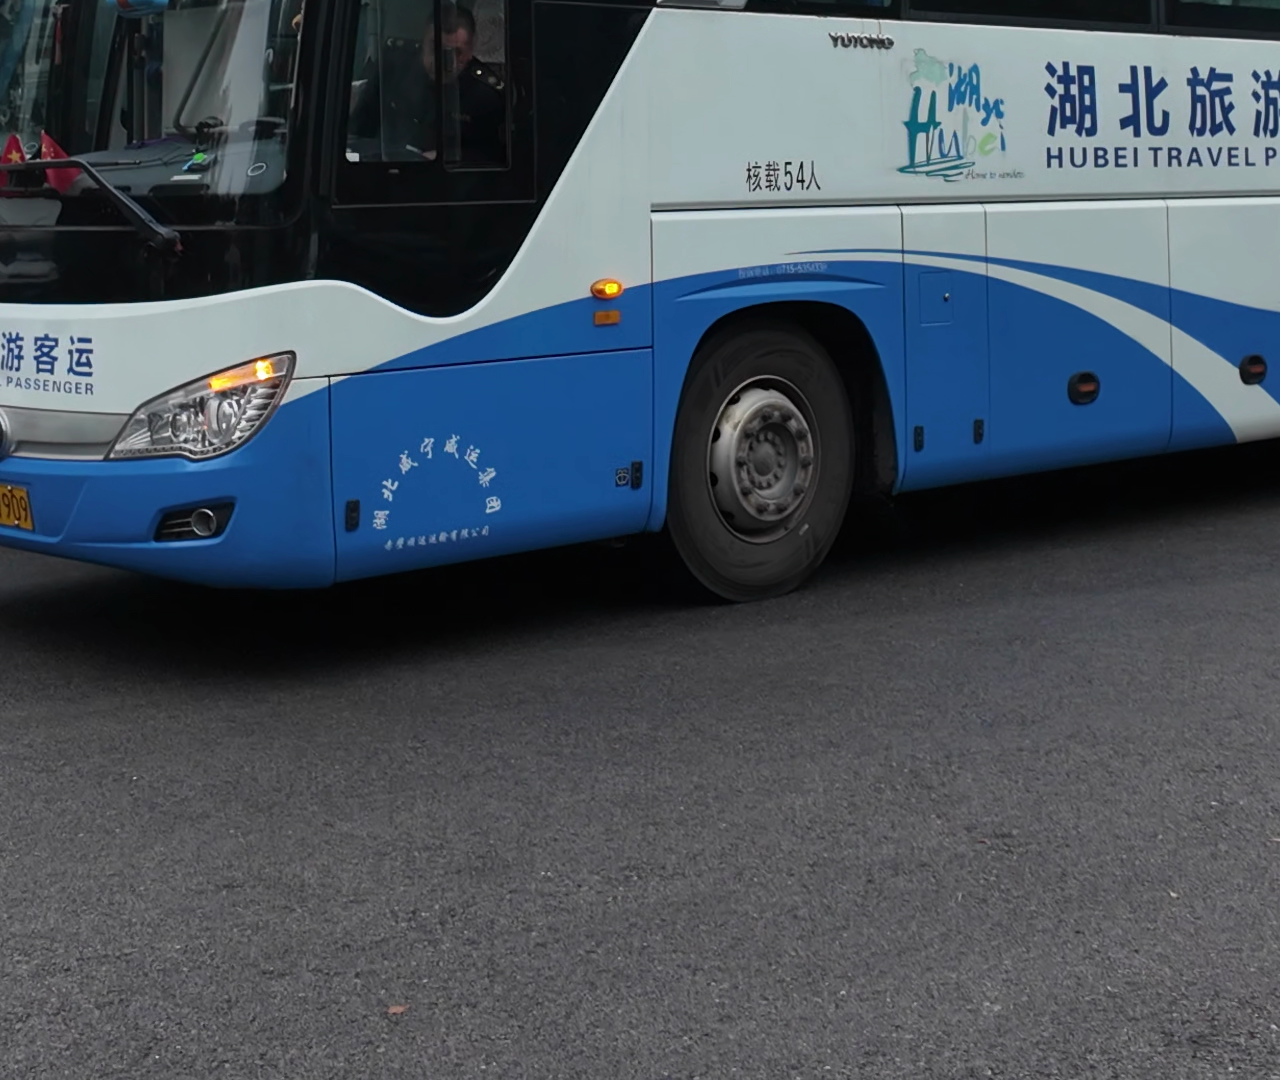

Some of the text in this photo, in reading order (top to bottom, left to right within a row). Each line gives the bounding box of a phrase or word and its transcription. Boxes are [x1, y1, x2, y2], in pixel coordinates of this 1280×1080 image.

[1046, 146, 1139, 169] HUBEI
[1148, 146, 1256, 169] TRAVEL
[746, 160, 821, 192] 核载54人
[6, 376, 95, 396] PASSENGER
